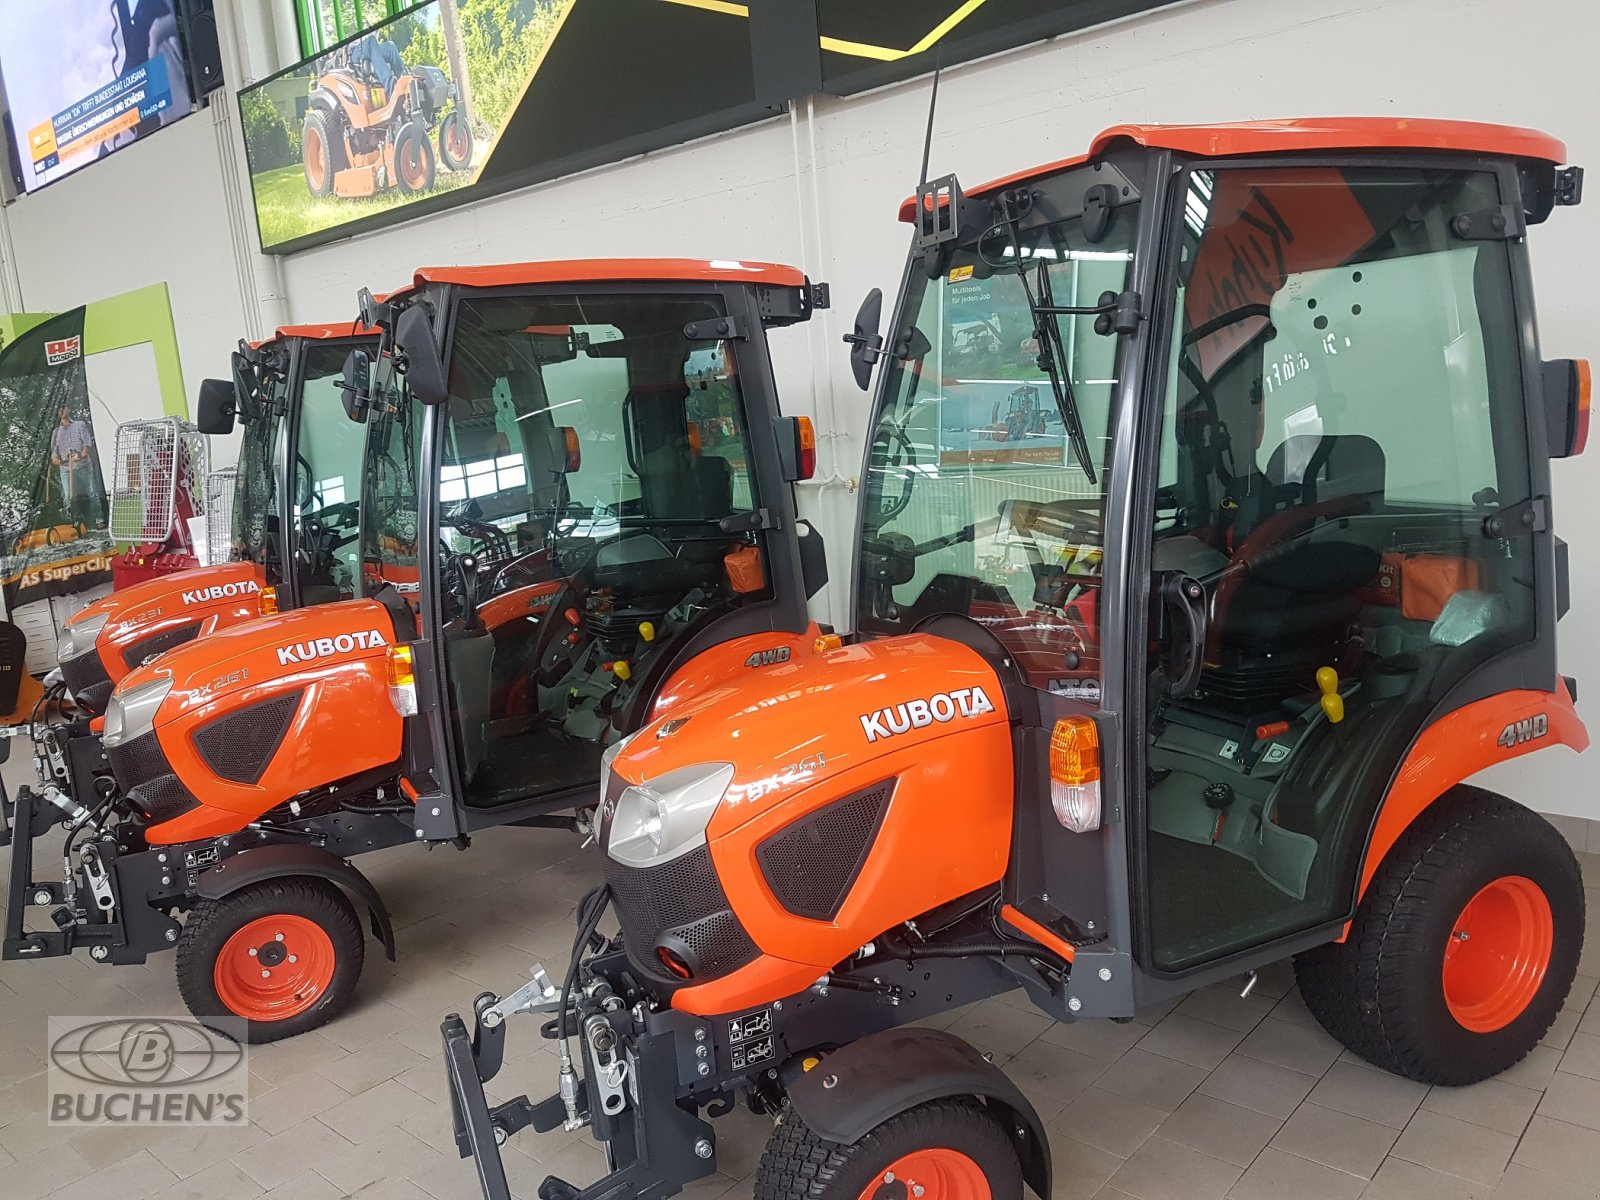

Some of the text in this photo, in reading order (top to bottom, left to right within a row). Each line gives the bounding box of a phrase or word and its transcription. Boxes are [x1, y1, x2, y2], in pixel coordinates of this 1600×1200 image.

[122, 67, 147, 89] LOUISIANA
[952, 285, 982, 295] Multitools
[961, 295, 978, 304] jeden
[979, 293, 991, 301] Job
[48, 336, 79, 356] AS
[19, 571, 41, 590] AS
[181, 580, 260, 606] KUBOTA
[276, 629, 387, 667] KUBOTA
[744, 646, 791, 668] 4WD
[859, 685, 996, 744] KUBOTA
[1497, 712, 1549, 748] 4WD
